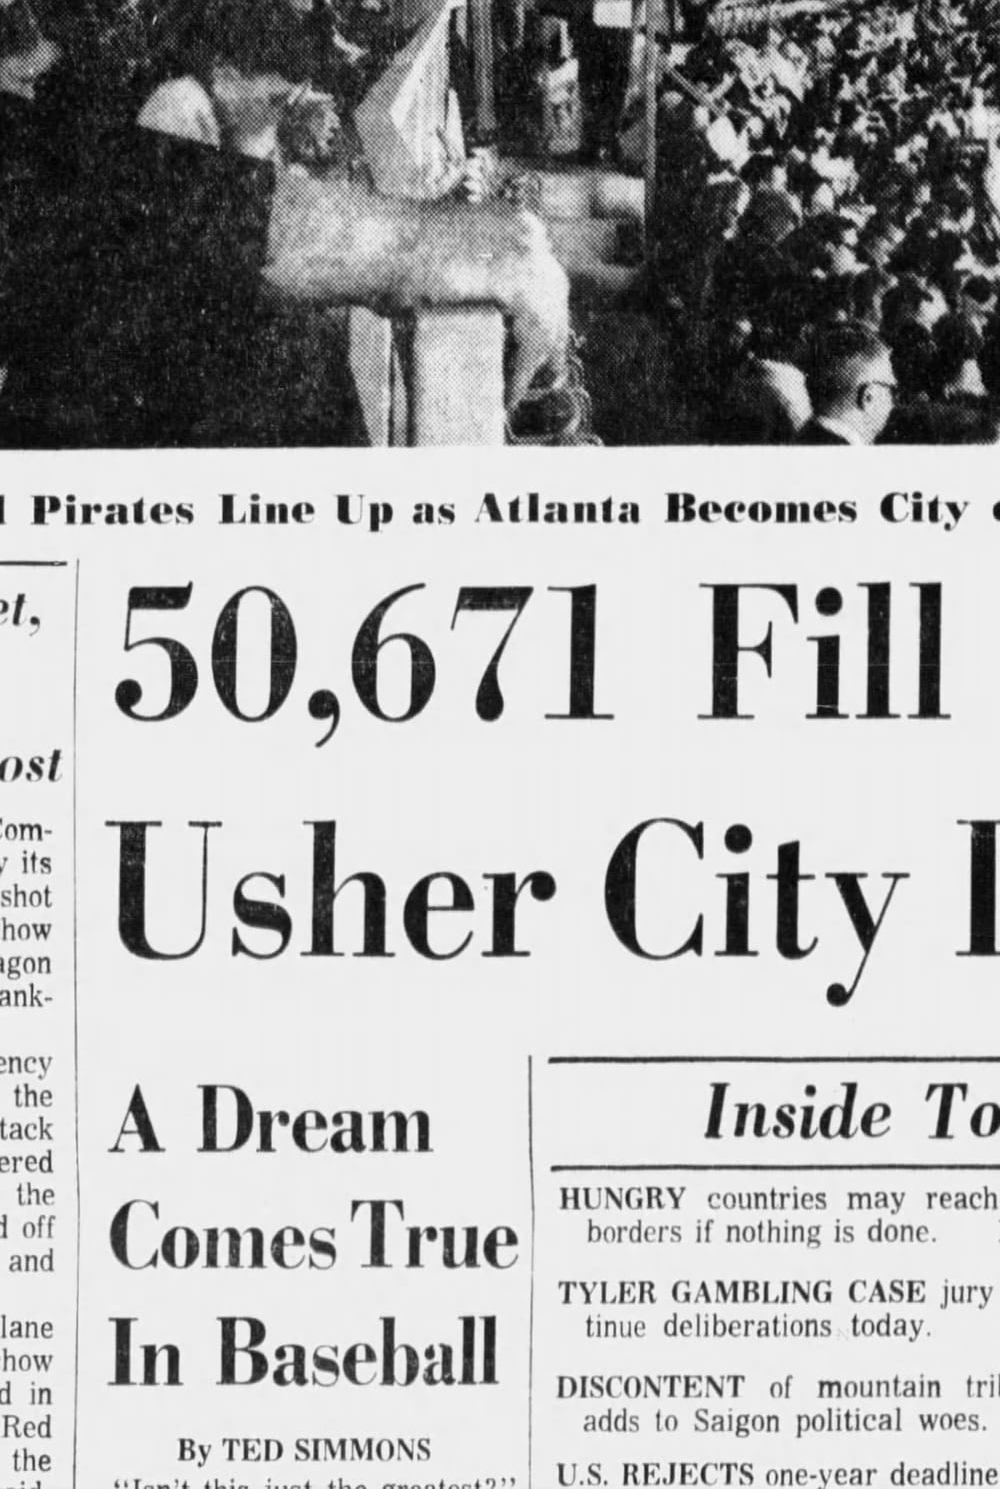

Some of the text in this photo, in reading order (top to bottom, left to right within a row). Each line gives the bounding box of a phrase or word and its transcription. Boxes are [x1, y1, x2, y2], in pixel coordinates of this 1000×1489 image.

[33, 494, 194, 525] Pirates
[220, 493, 315, 524] Line
[337, 494, 394, 533] Up
[412, 503, 456, 524] as
[475, 492, 640, 524] Atlanta
[666, 492, 858, 524] Becomes
[880, 491, 968, 531] City
[114, 581, 615, 748] 50,671
[697, 581, 951, 720] Fill
[22, 849, 52, 874] its
[105, 819, 557, 961] Usher
[604, 817, 911, 1007] City
[13, 1082, 53, 1108] the
[108, 1084, 430, 1154] A Dream
[704, 1082, 892, 1140] Inside
[16, 1182, 55, 1206] the
[559, 1186, 686, 1210] HUNGRY
[707, 1185, 827, 1210] countries
[847, 1191, 906, 1215] may
[926, 1185, 998, 1211] reach
[22, 1214, 56, 1239] off
[109, 1199, 518, 1270] Comes True
[587, 1218, 682, 1244] borders
[696, 1218, 714, 1243] if
[726, 1219, 821, 1248] nothing
[834, 1218, 855, 1243] is
[867, 1218, 936, 1243] done.
[8, 1247, 54, 1272] and
[558, 1280, 657, 1305] TYLER
[671, 1279, 832, 1305] GAMBLING
[848, 1279, 926, 1304] CASE
[940, 1285, 993, 1310] jury
[585, 1315, 646, 1338] tinue
[663, 1312, 832, 1338] deliberations
[851, 1312, 931, 1343] today.
[108, 1315, 499, 1387] In Baseball
[31, 1381, 52, 1405] in
[557, 1374, 746, 1399] DISCONTENT
[769, 1374, 793, 1399] of
[818, 1374, 941, 1399] mountain
[2, 1414, 52, 1439] Red
[583, 1407, 640, 1433] adds
[655, 1410, 679, 1432] to
[694, 1408, 780, 1438] Saigon
[796, 1407, 902, 1439] political
[919, 1413, 987, 1432] woes.
[12, 1447, 52, 1472] the
[178, 1437, 431, 1468] By TED SIMMONS
[557, 1462, 608, 1487] U.S.
[622, 1462, 755, 1487] REJECTS
[765, 1468, 878, 1489] one-year
[890, 1460, 998, 1487] deadline
